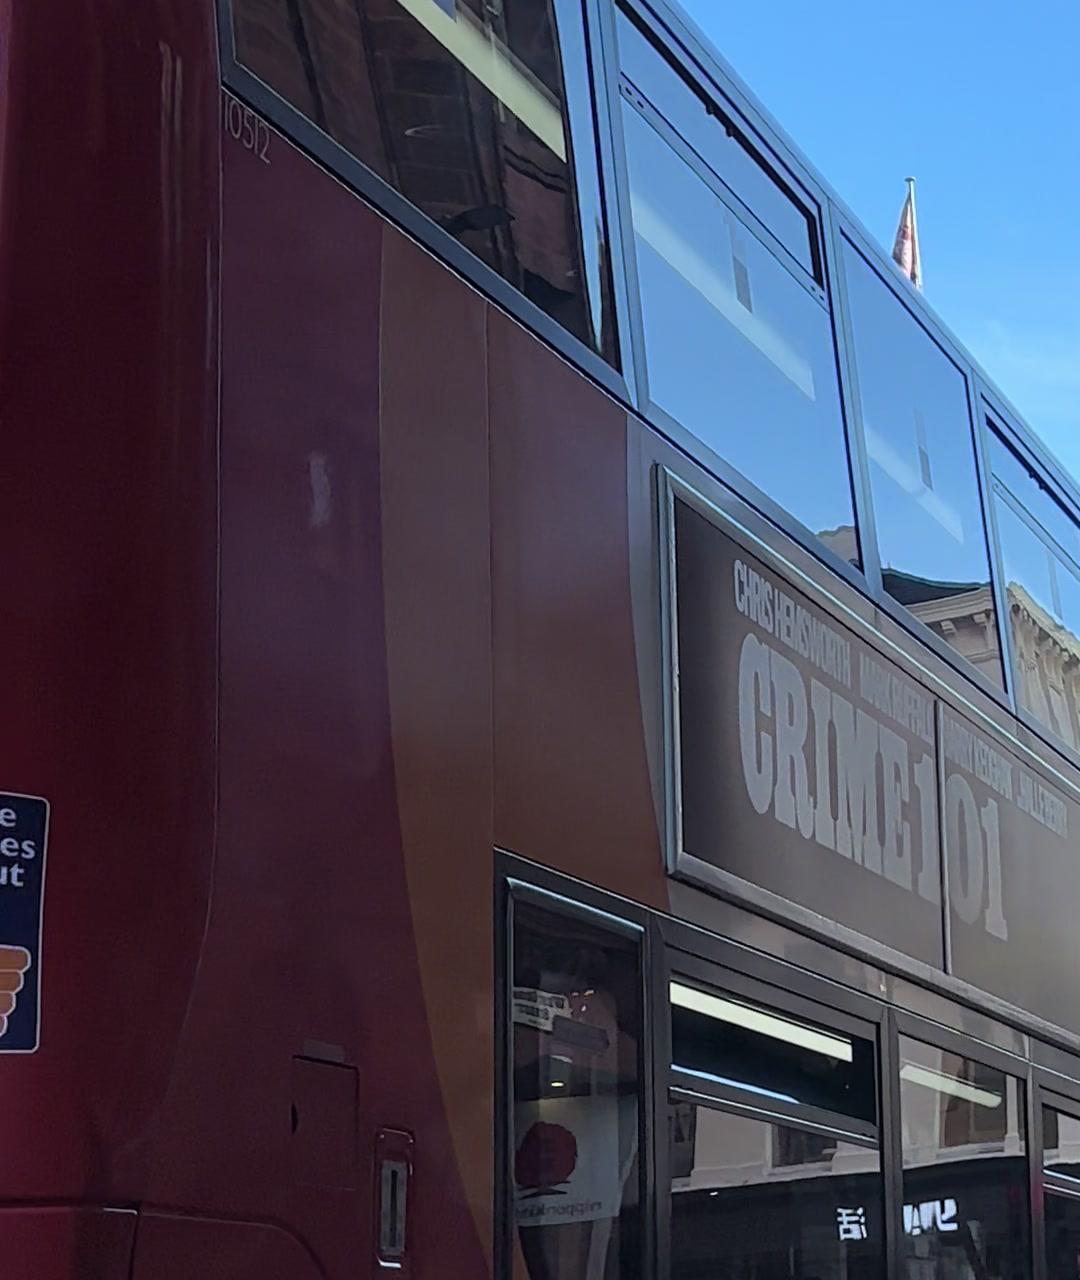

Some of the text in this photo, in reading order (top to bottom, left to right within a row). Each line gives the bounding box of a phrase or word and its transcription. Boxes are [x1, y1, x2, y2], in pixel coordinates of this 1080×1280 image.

[224, 94, 271, 164] 10512
[734, 557, 773, 634] CHRIS
[738, 632, 1008, 942] CRIME 101
